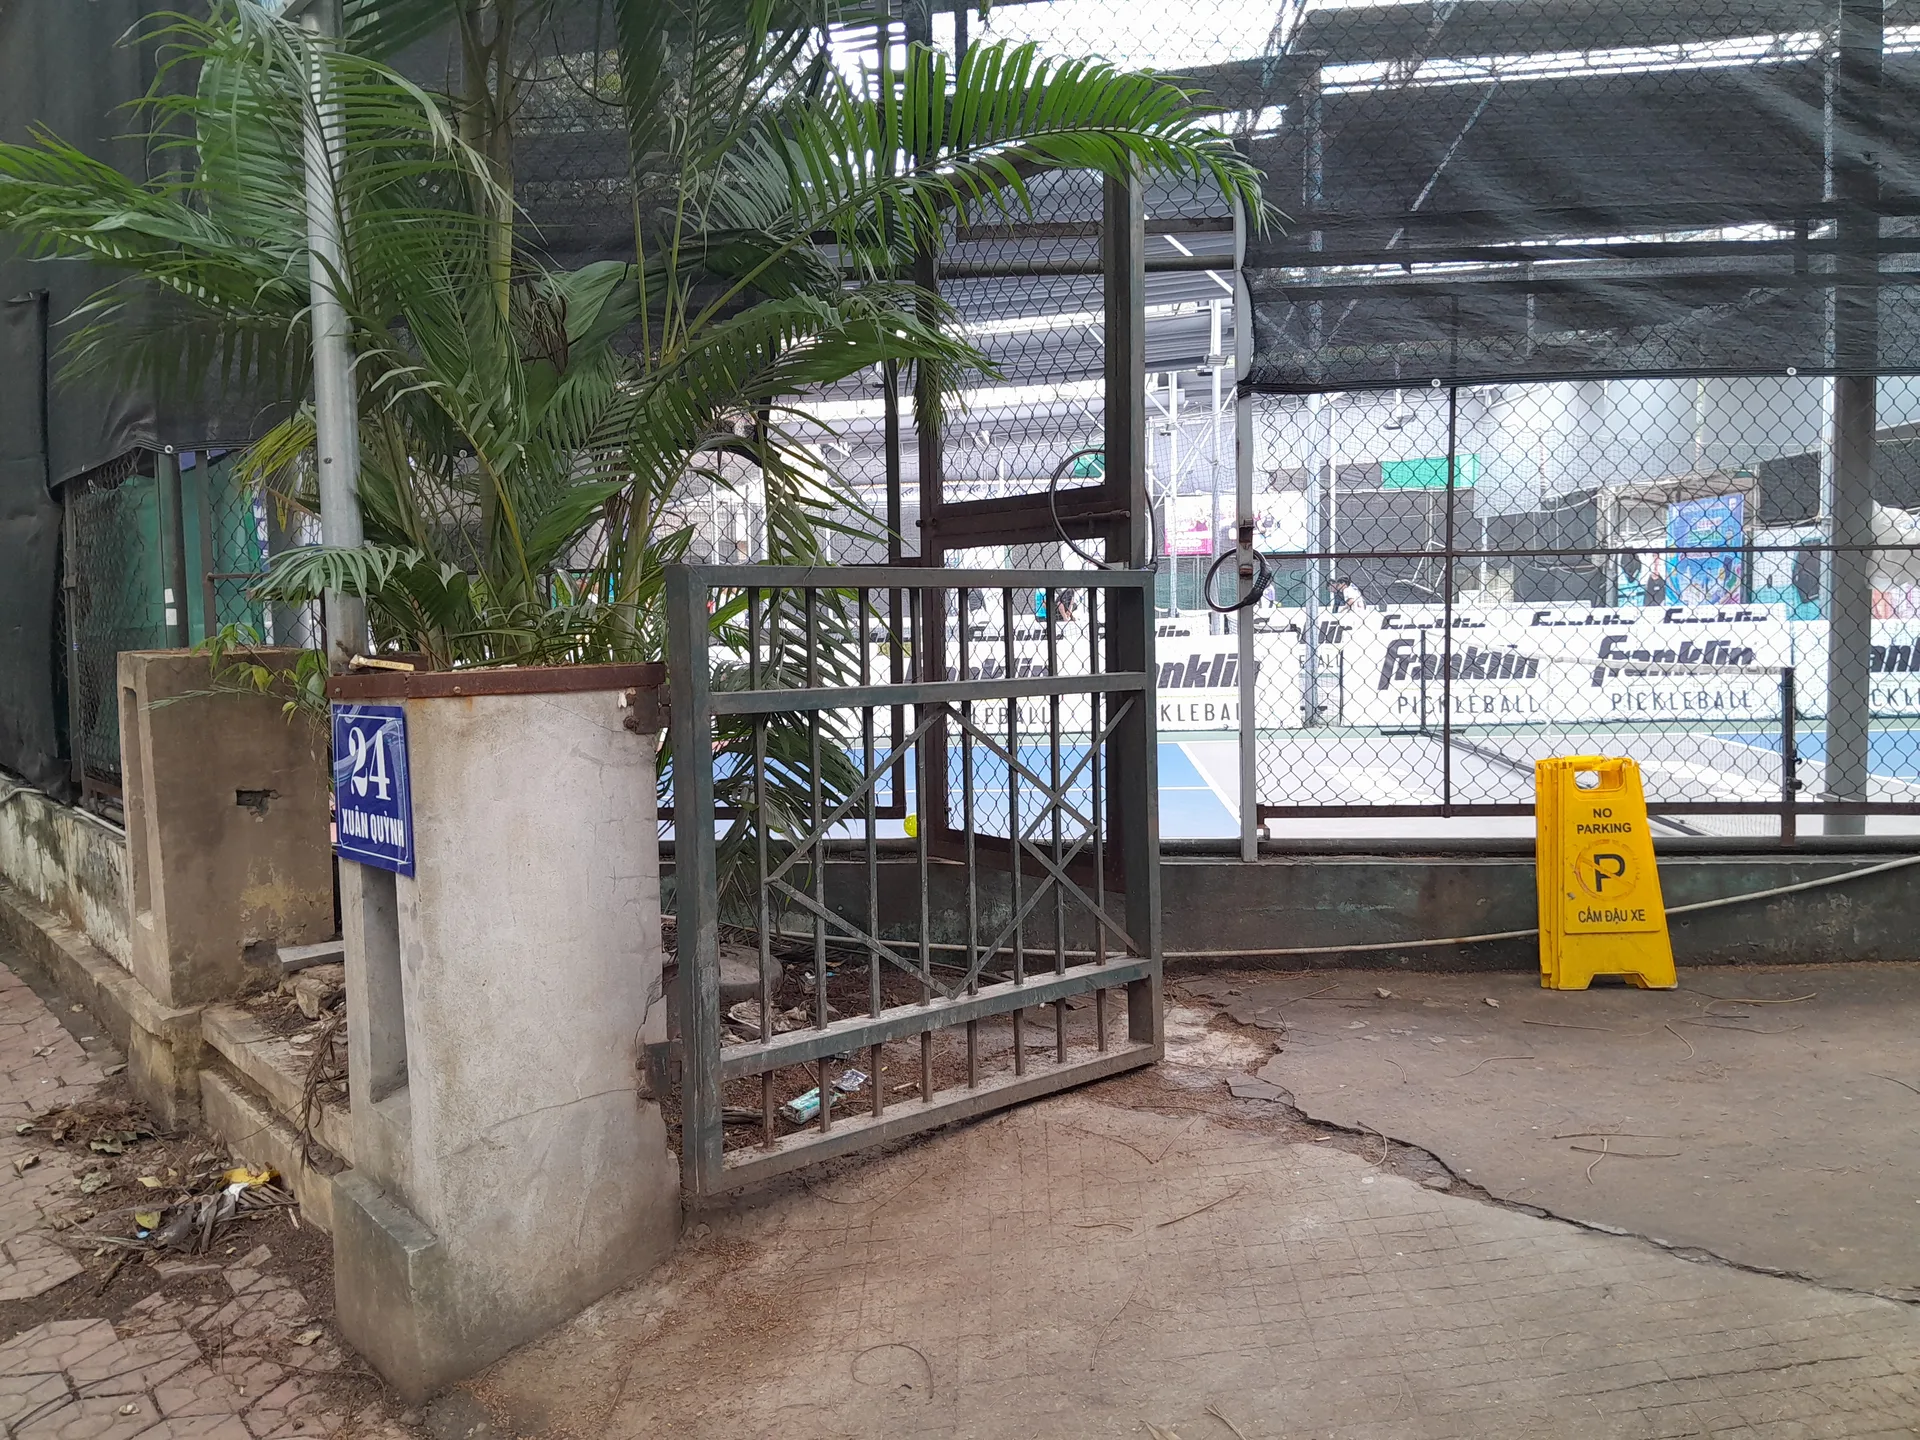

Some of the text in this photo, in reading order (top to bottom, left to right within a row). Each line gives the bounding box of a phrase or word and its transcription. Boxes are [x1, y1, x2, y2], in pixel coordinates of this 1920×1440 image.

[1612, 690, 1752, 710] PICKLEBALL
[349, 726, 391, 800] 24
[1592, 808, 1612, 818] NO
[342, 805, 405, 847] XUÂN QUỲNH
[1577, 822, 1632, 834] PARKING
[1631, 909, 1646, 921] XE
